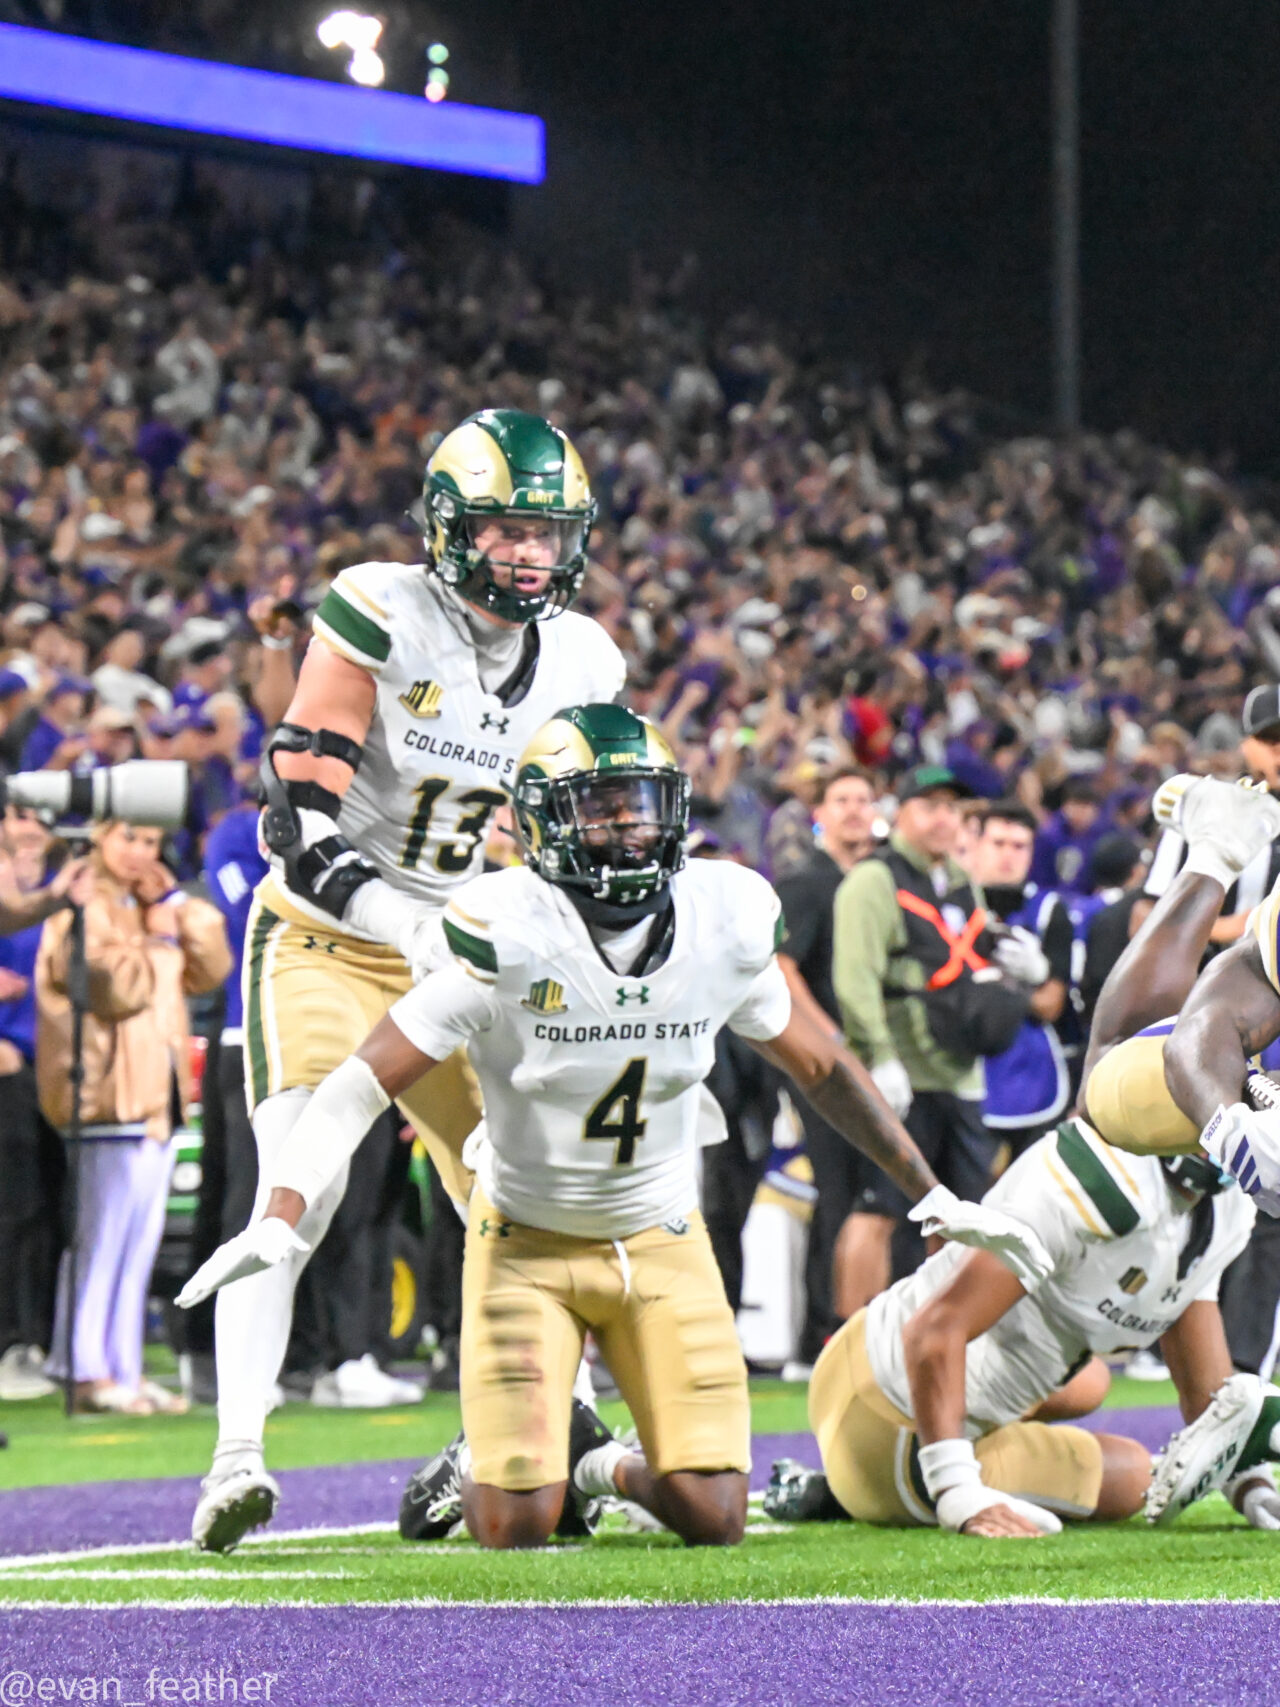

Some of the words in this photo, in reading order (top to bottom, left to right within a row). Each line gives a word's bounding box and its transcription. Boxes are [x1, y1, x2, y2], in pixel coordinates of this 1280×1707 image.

[404, 729, 500, 770] COLORADO
[397, 773, 511, 874] 13
[534, 1023, 646, 1043] COLORADO
[655, 1017, 711, 1040] STATE
[580, 1054, 649, 1170] 4
